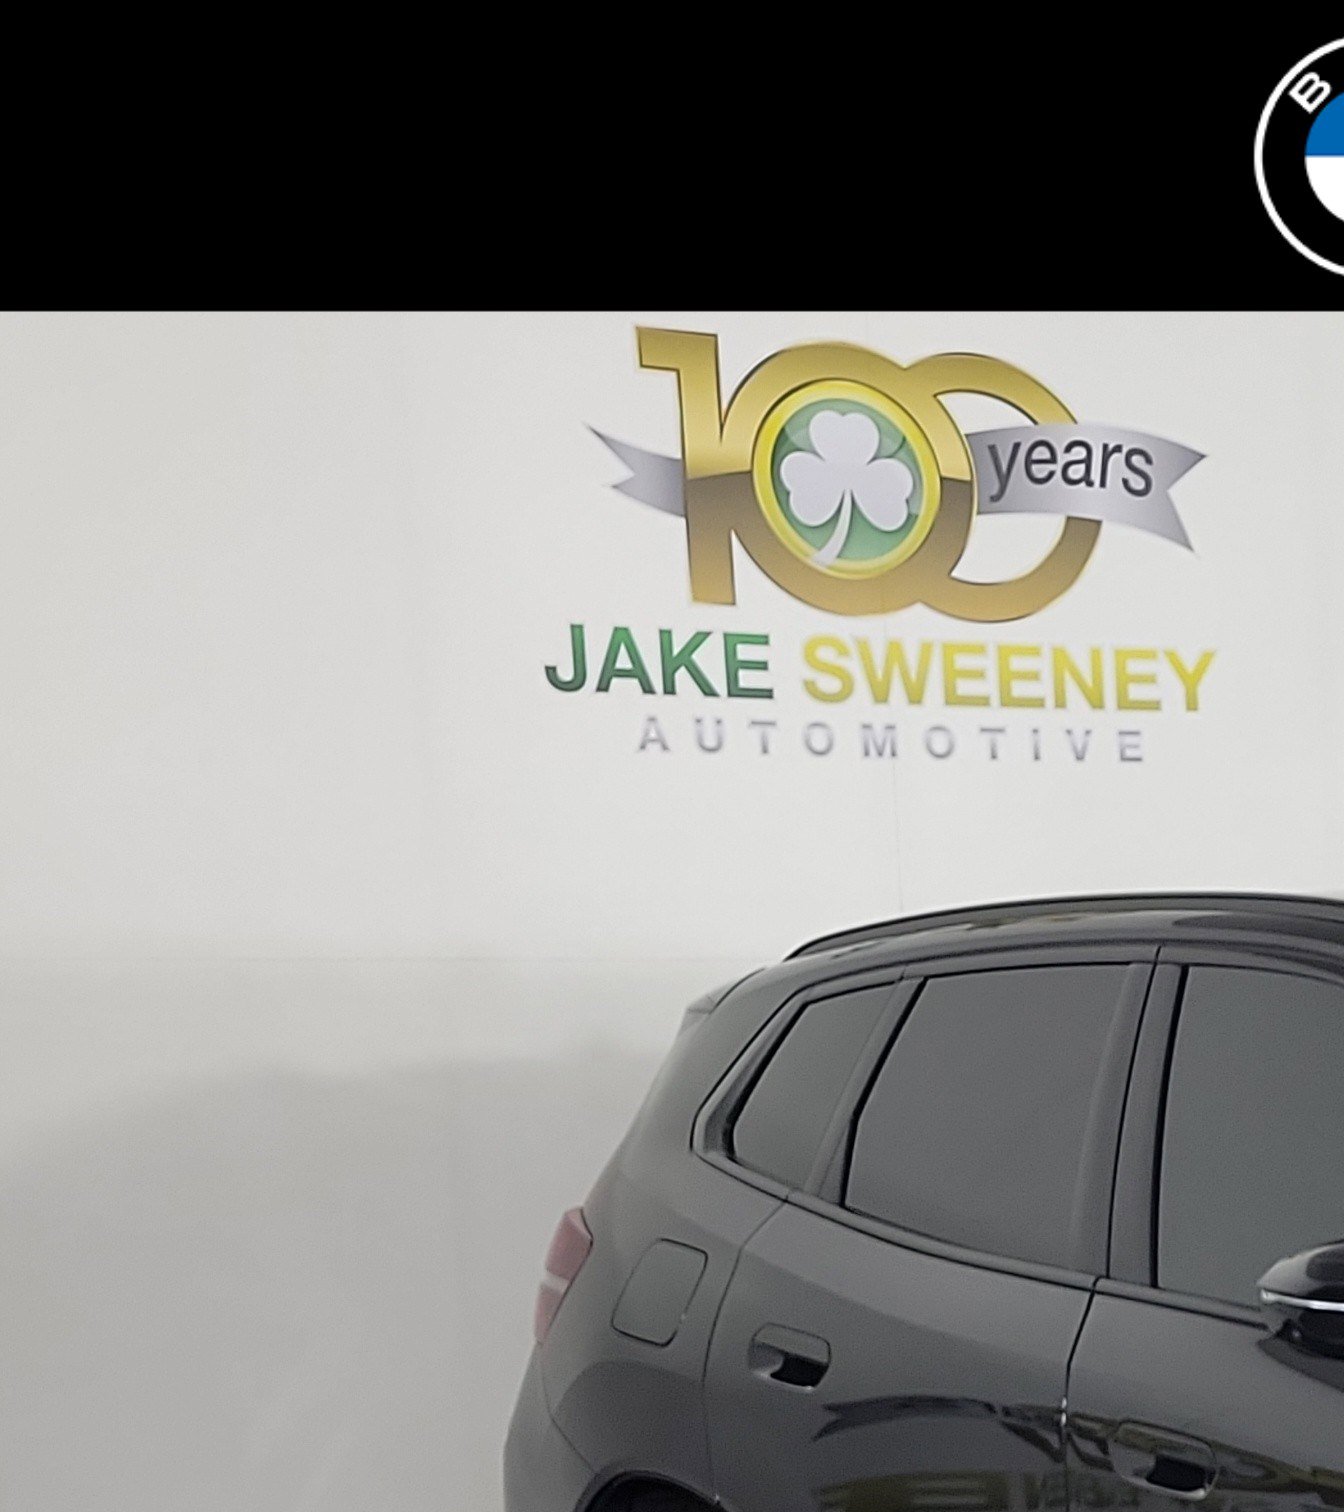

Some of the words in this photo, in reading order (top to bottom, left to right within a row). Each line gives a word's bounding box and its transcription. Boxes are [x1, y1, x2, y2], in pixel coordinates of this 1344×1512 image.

[635, 326, 1102, 624] 100
[987, 440, 1154, 501] years
[545, 624, 774, 699] JAKE
[802, 635, 1215, 711] SWEENEY
[638, 717, 1145, 763] AUTOMOTIVE
